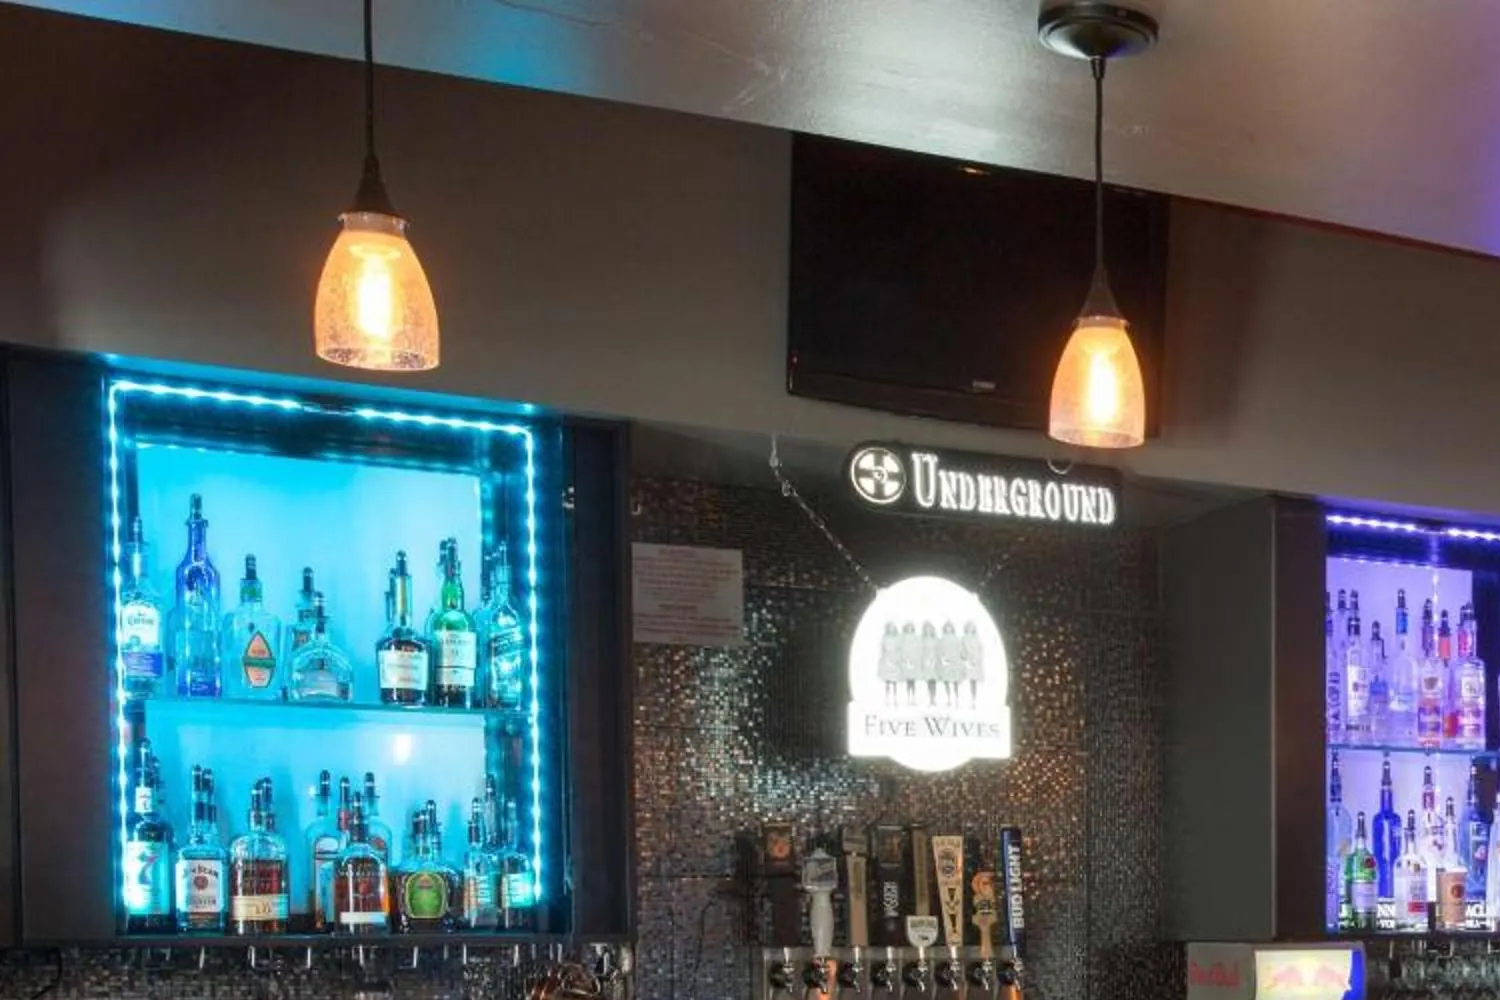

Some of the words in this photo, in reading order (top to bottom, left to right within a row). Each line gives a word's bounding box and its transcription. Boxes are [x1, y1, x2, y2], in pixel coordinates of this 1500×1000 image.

[911, 452, 1117, 525] UNDERGROUND
[865, 714, 917, 737] FIVE
[924, 716, 1001, 737] WIVES
[1008, 842, 1022, 891] LIGHT
[1010, 892, 1025, 929] BUD
